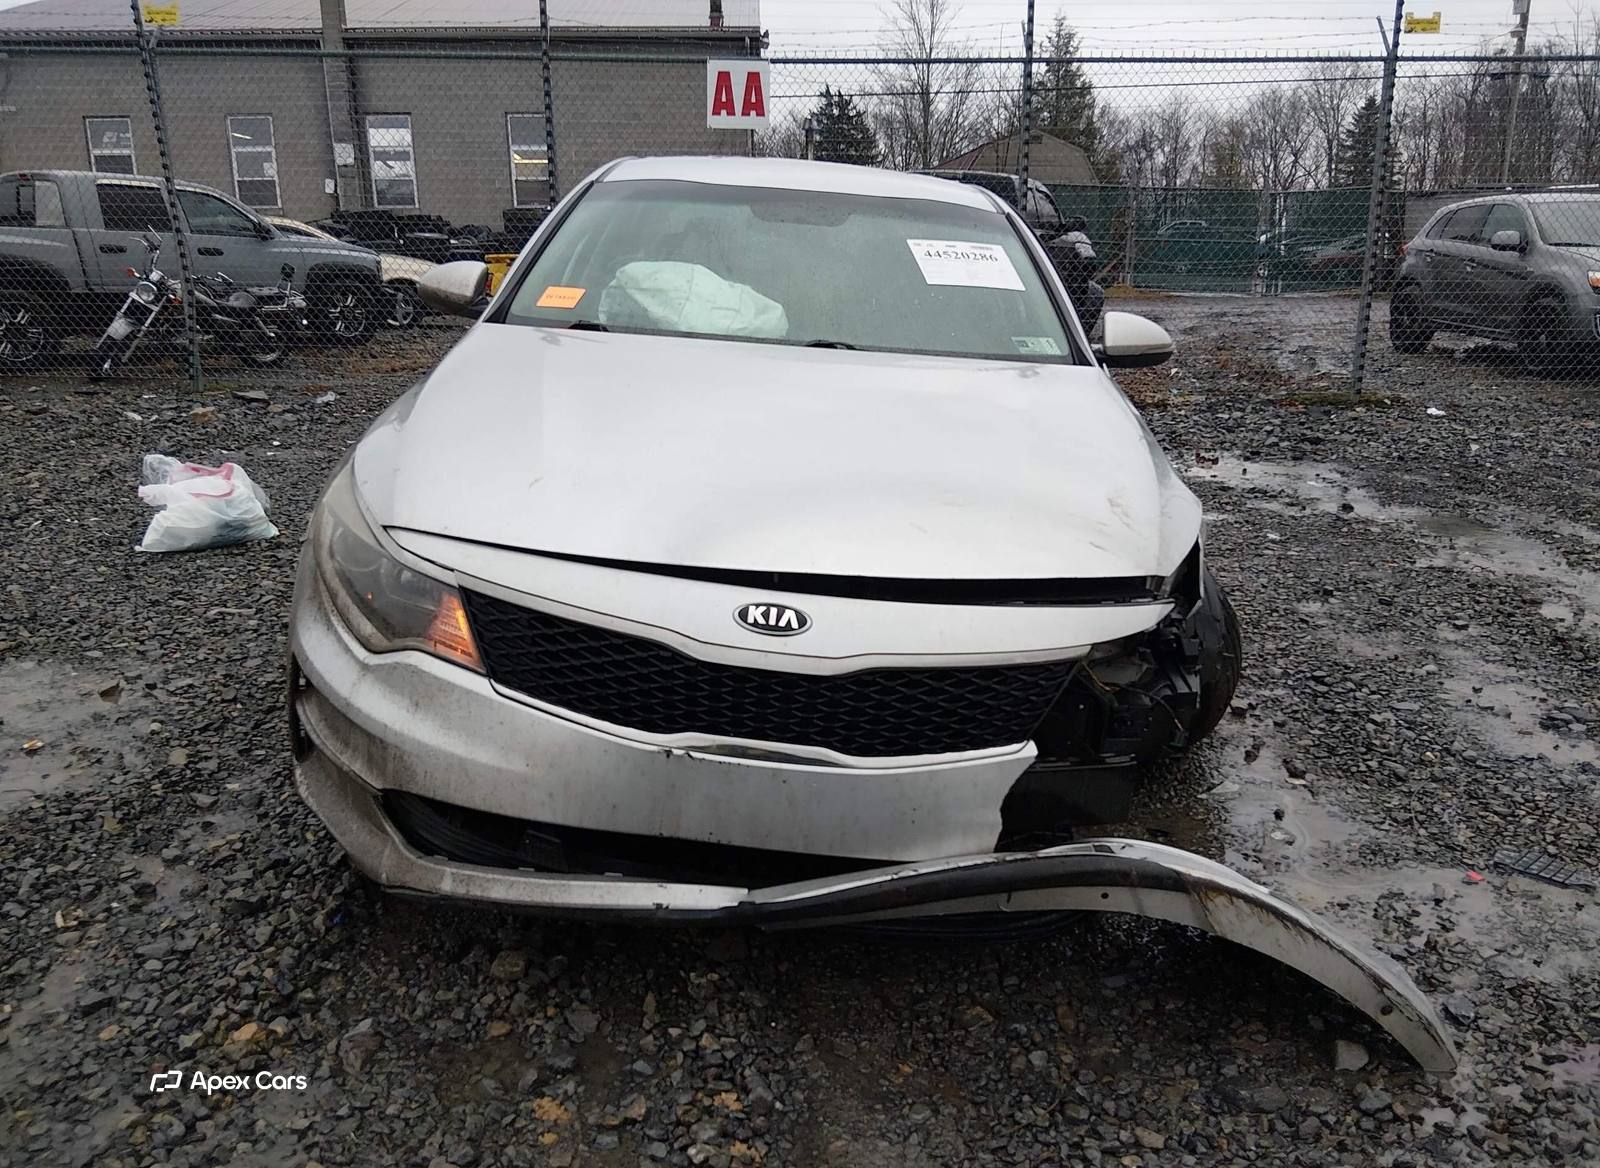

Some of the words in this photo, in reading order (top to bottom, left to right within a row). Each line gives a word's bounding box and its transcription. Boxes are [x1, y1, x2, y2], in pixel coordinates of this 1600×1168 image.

[711, 70, 766, 117] AA
[923, 250, 998, 262] 44520286
[746, 605, 799, 630] KIA
